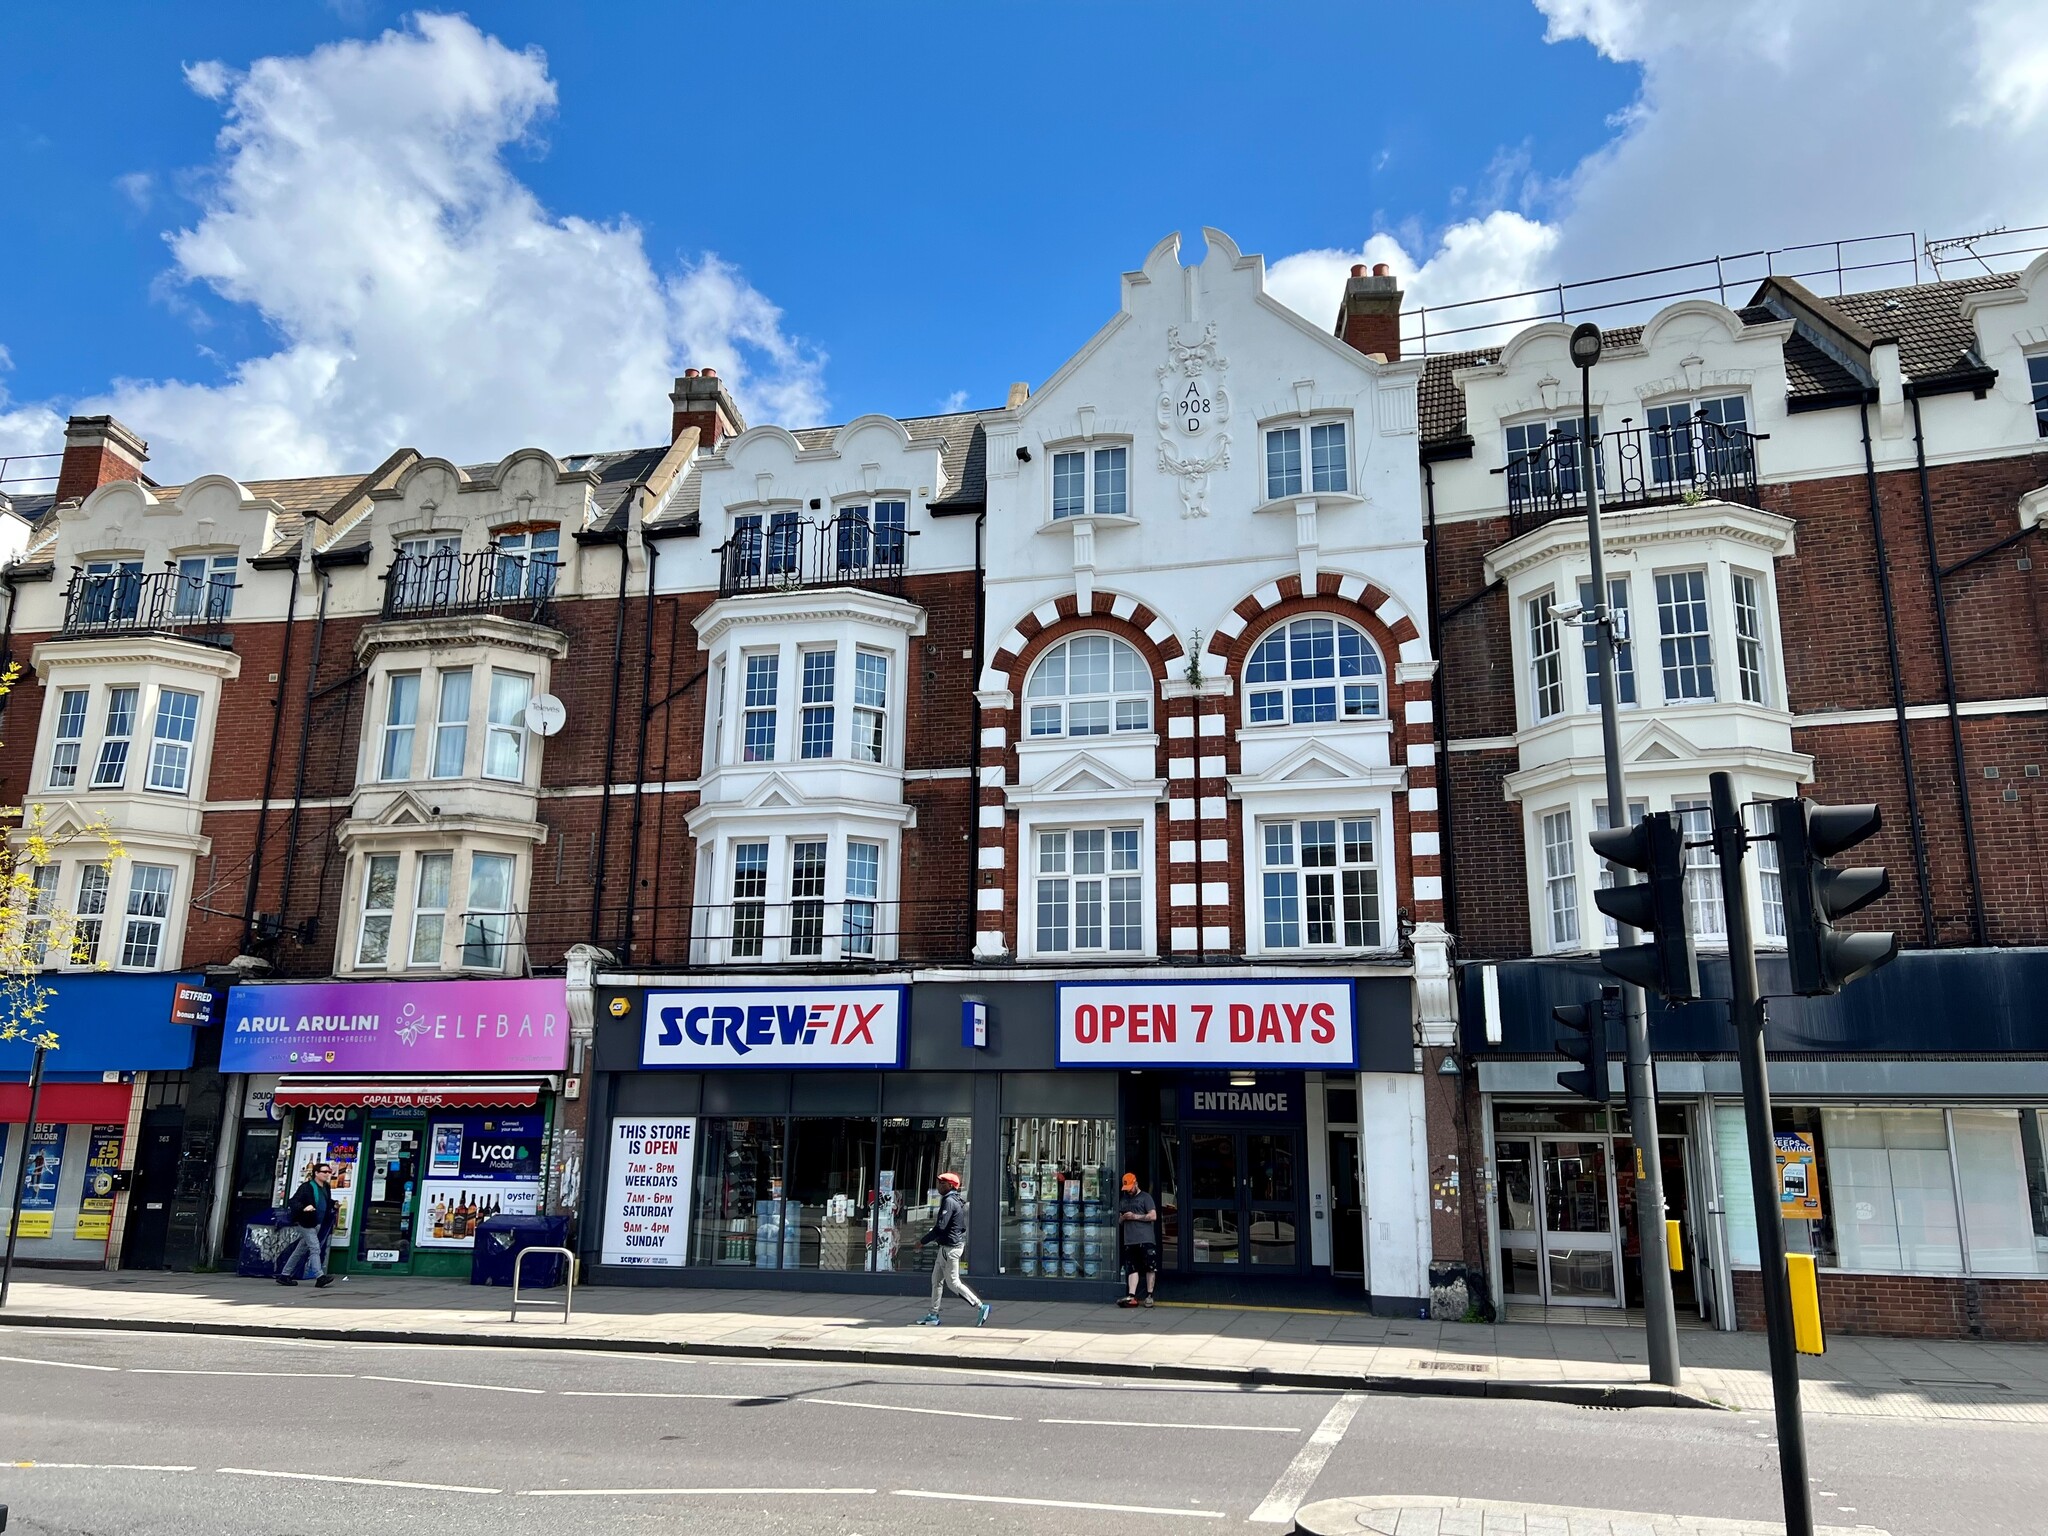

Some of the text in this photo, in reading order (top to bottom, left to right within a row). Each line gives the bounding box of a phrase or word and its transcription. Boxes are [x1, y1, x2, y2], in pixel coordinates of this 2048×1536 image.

[1185, 382, 1200, 398] A
[1176, 399, 1210, 416] 1908
[1188, 418, 1200, 432] D
[180, 989, 212, 1003] BETFRED
[202, 1005, 211, 1014] the
[176, 1010, 210, 1022] bonus king
[236, 1014, 380, 1032] ARUL ARULINI
[434, 1014, 556, 1038] ELFBAR
[1073, 1002, 1336, 1044] OPEN 7 DAYS
[658, 1003, 885, 1056] SCREWFIX
[234, 1036, 247, 1044] OFF
[362, 1095, 442, 1104] CAPALINA NEWS
[1194, 1091, 1288, 1112] ENTRANCE
[308, 1106, 346, 1124] Lyca
[392, 1108, 412, 1116] Ticket
[35, 1123, 56, 1132] BET
[619, 1125, 691, 1140] THIS STORE
[472, 1142, 515, 1163] Lyca
[628, 1140, 678, 1154] IS OPEN
[628, 1162, 646, 1173] 7AM
[656, 1162, 674, 1173] 8PM
[625, 1176, 678, 1187] WEEKDAYS
[507, 1192, 536, 1202] oyster
[626, 1192, 644, 1203] 7AM
[654, 1192, 672, 1204] 6PM
[622, 1206, 674, 1217] SATURDAY
[624, 1222, 642, 1232] 9AM
[650, 1222, 670, 1233] 4PM
[626, 1235, 665, 1247] SUNDAY
[620, 1256, 651, 1264] SCREWFIX
